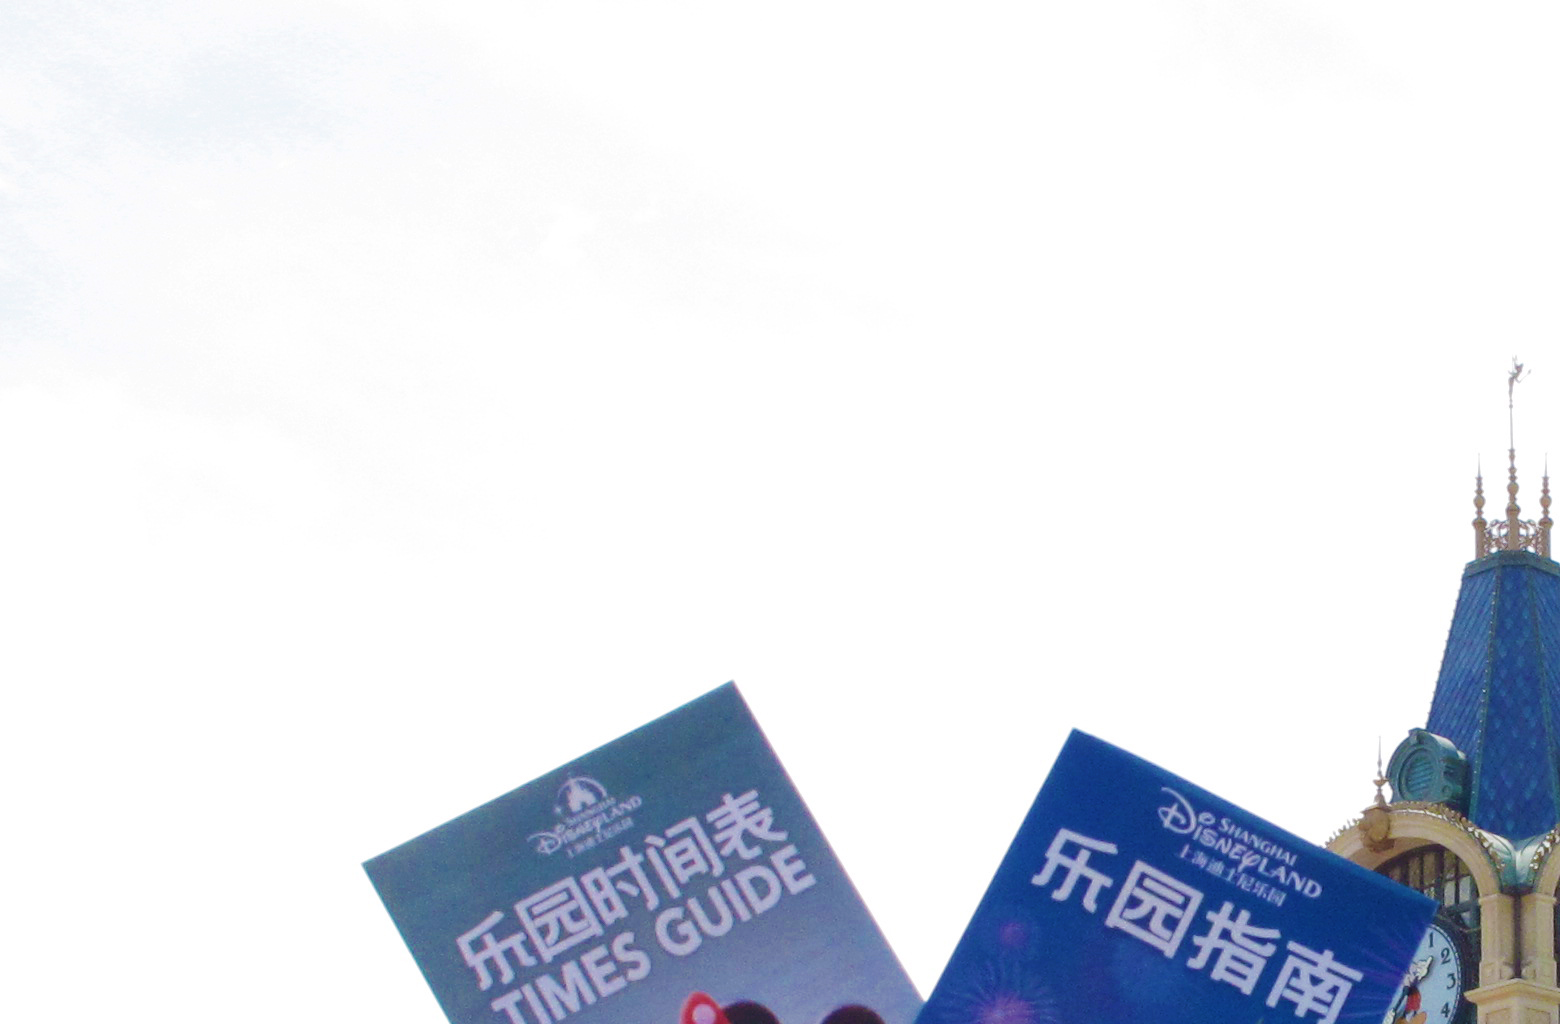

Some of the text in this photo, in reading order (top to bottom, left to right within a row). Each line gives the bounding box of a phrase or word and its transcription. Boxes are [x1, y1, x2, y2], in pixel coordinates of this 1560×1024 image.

[1157, 786, 1323, 898] DISNEYLAND
[1219, 817, 1298, 867] SHANGHAI
[456, 789, 789, 991] 乐园时间表
[654, 843, 817, 957] GUIDE
[1428, 931, 1434, 948] 1
[1440, 947, 1451, 965] 2
[1446, 973, 1456, 990] 3
[1440, 1002, 1449, 1018] 4
